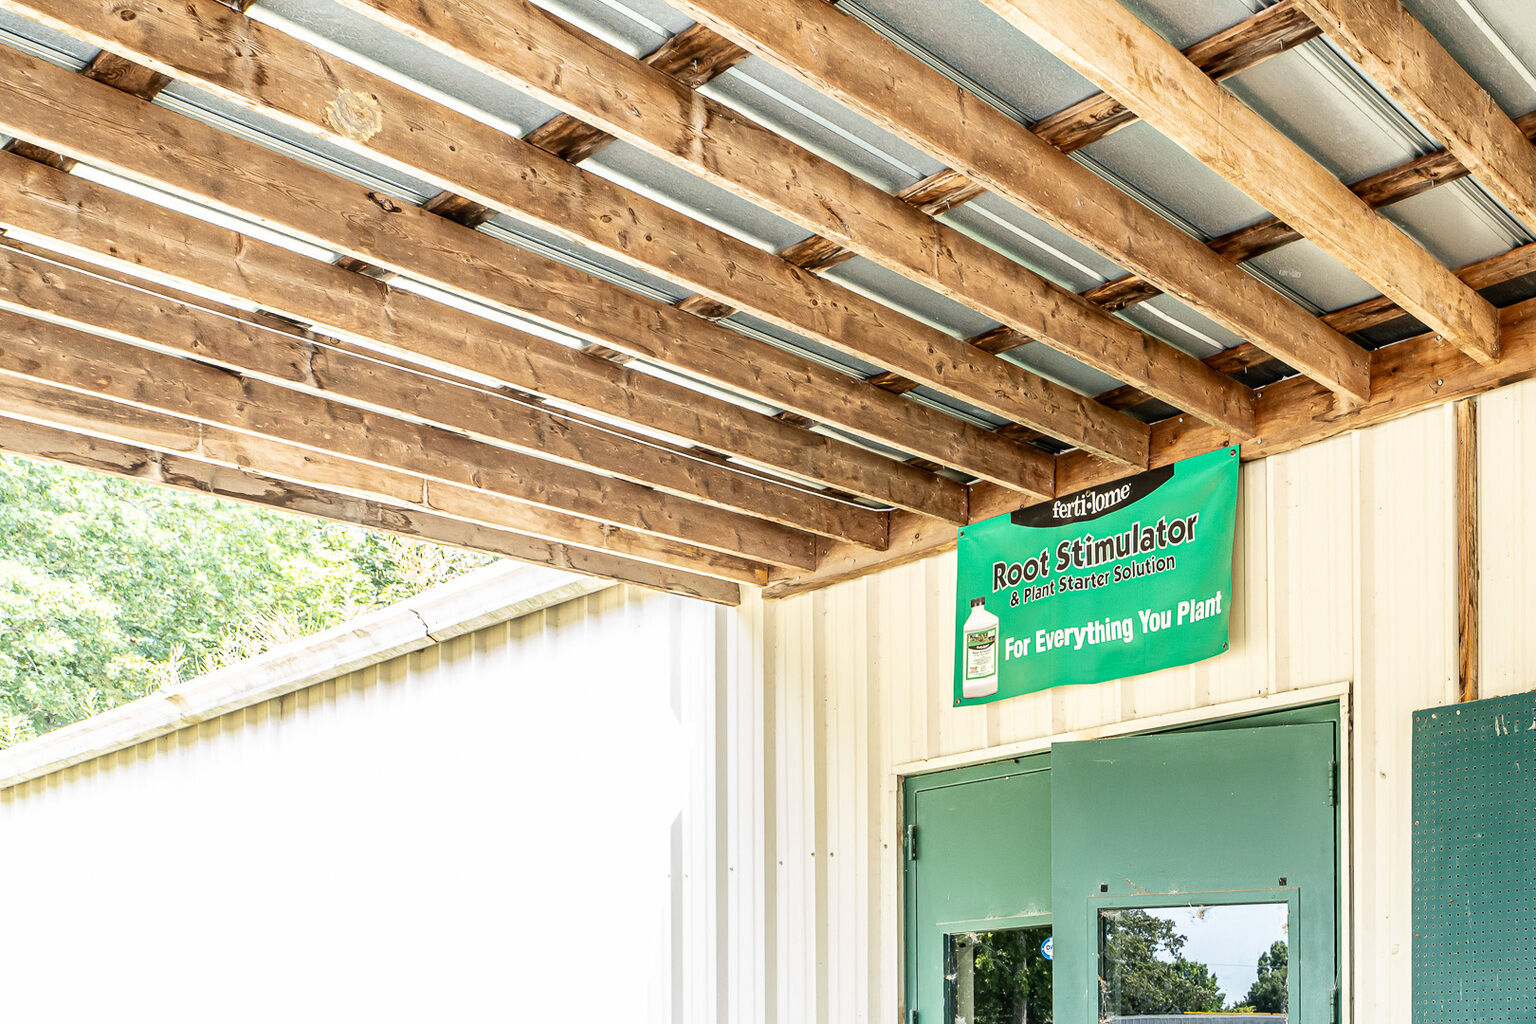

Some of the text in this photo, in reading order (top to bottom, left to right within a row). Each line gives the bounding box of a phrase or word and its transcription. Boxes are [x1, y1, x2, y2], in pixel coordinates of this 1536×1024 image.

[992, 513, 1199, 593] Root Stimulator
[1010, 555, 1175, 607] & Plant Starter Solution
[1004, 591, 1222, 661] For Everything You Plant
